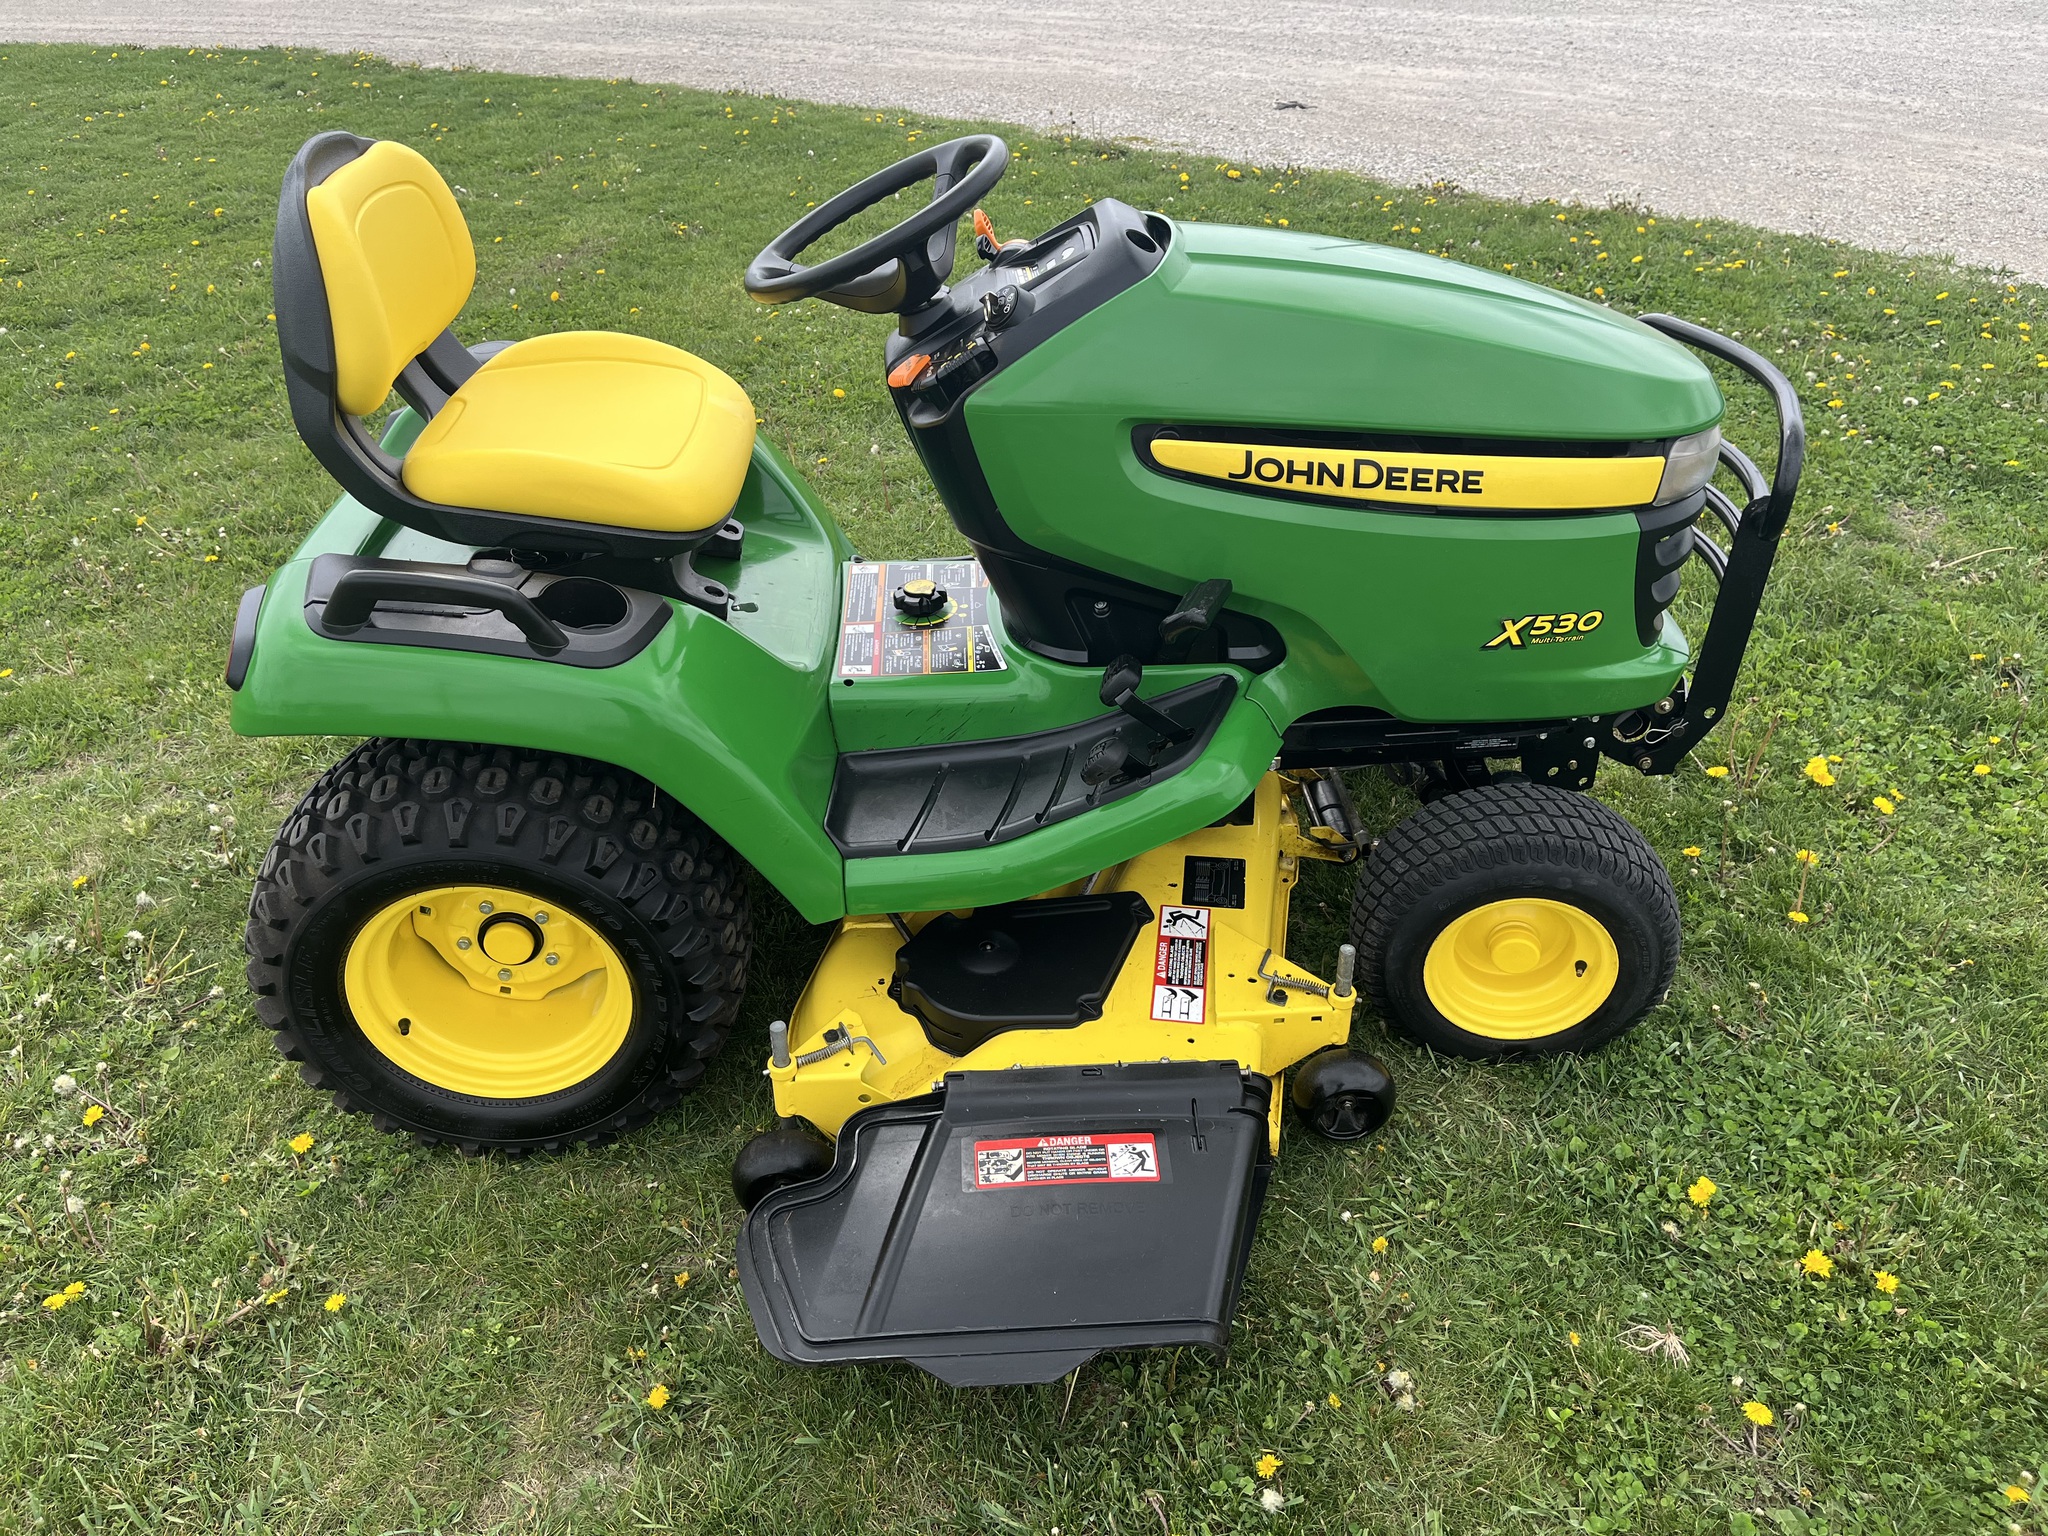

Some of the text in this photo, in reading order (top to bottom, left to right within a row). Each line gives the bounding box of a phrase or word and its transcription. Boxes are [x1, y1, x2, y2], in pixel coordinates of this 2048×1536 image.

[1228, 450, 1484, 494] JOHN DEERE
[1481, 610, 1604, 649] X530
[1530, 635, 1585, 644] Multi-Terrain
[1157, 942, 1168, 971] DANGER
[1049, 1136, 1092, 1146] DANGER
[1010, 1202, 1145, 1218] DO NOT REMOVE
